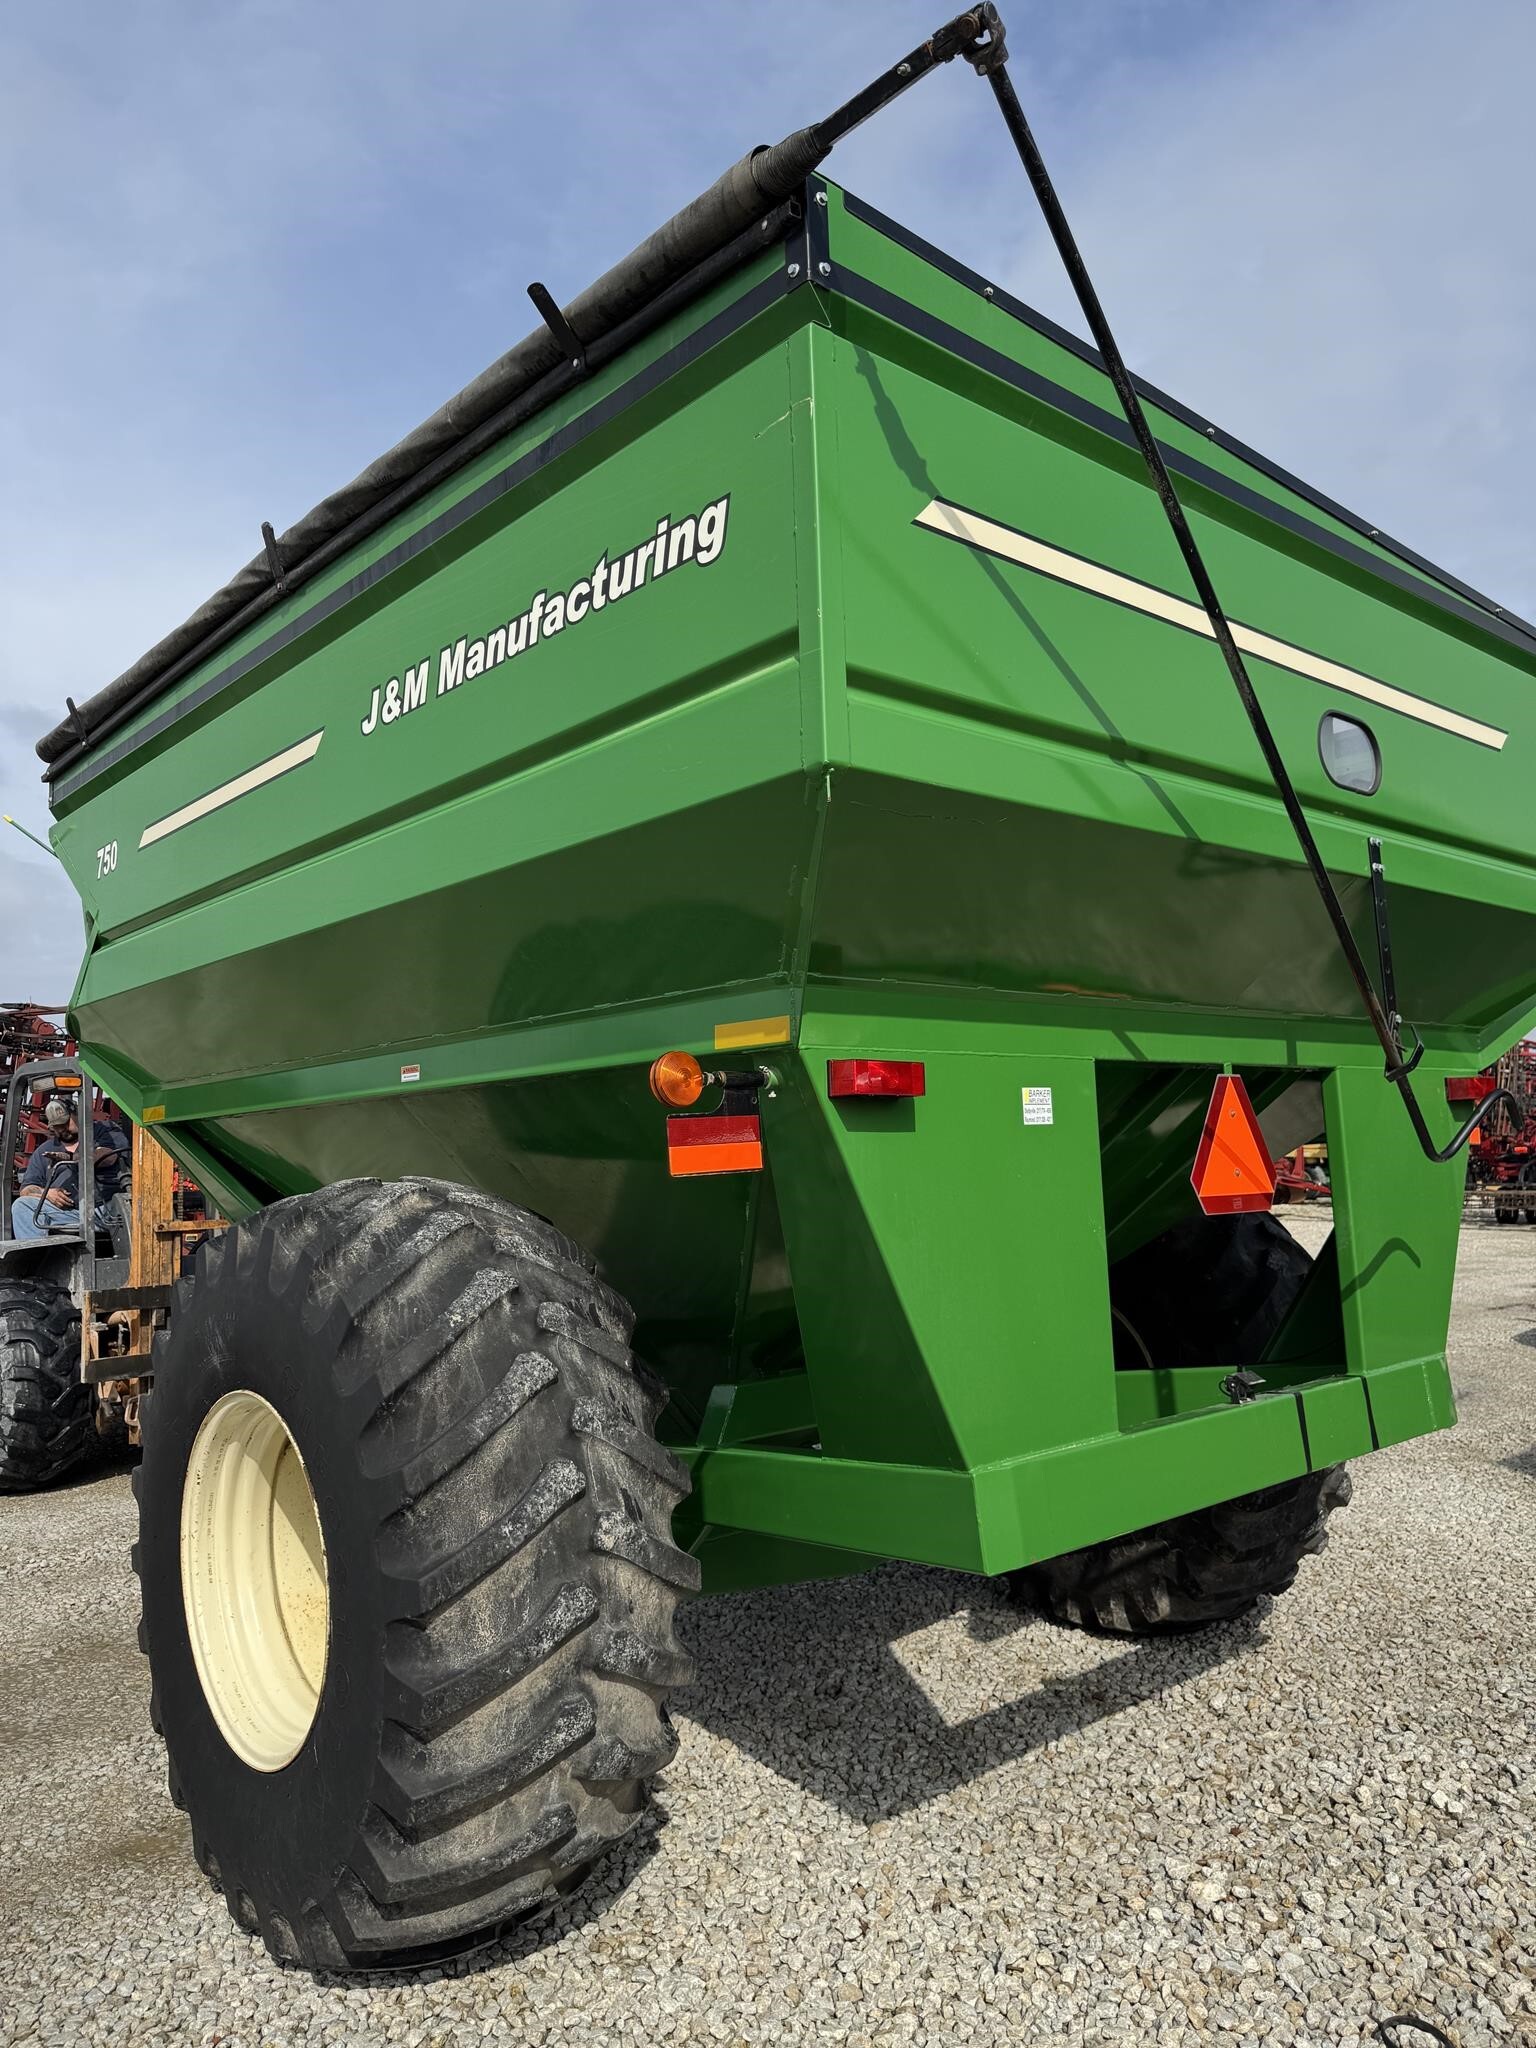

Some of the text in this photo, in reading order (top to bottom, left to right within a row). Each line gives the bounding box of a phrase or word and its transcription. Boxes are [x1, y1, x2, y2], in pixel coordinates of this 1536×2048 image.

[361, 492, 731, 735] J&M Manufacturing
[96, 839, 118, 880] 750
[1028, 1089, 1051, 1097] BARKER
